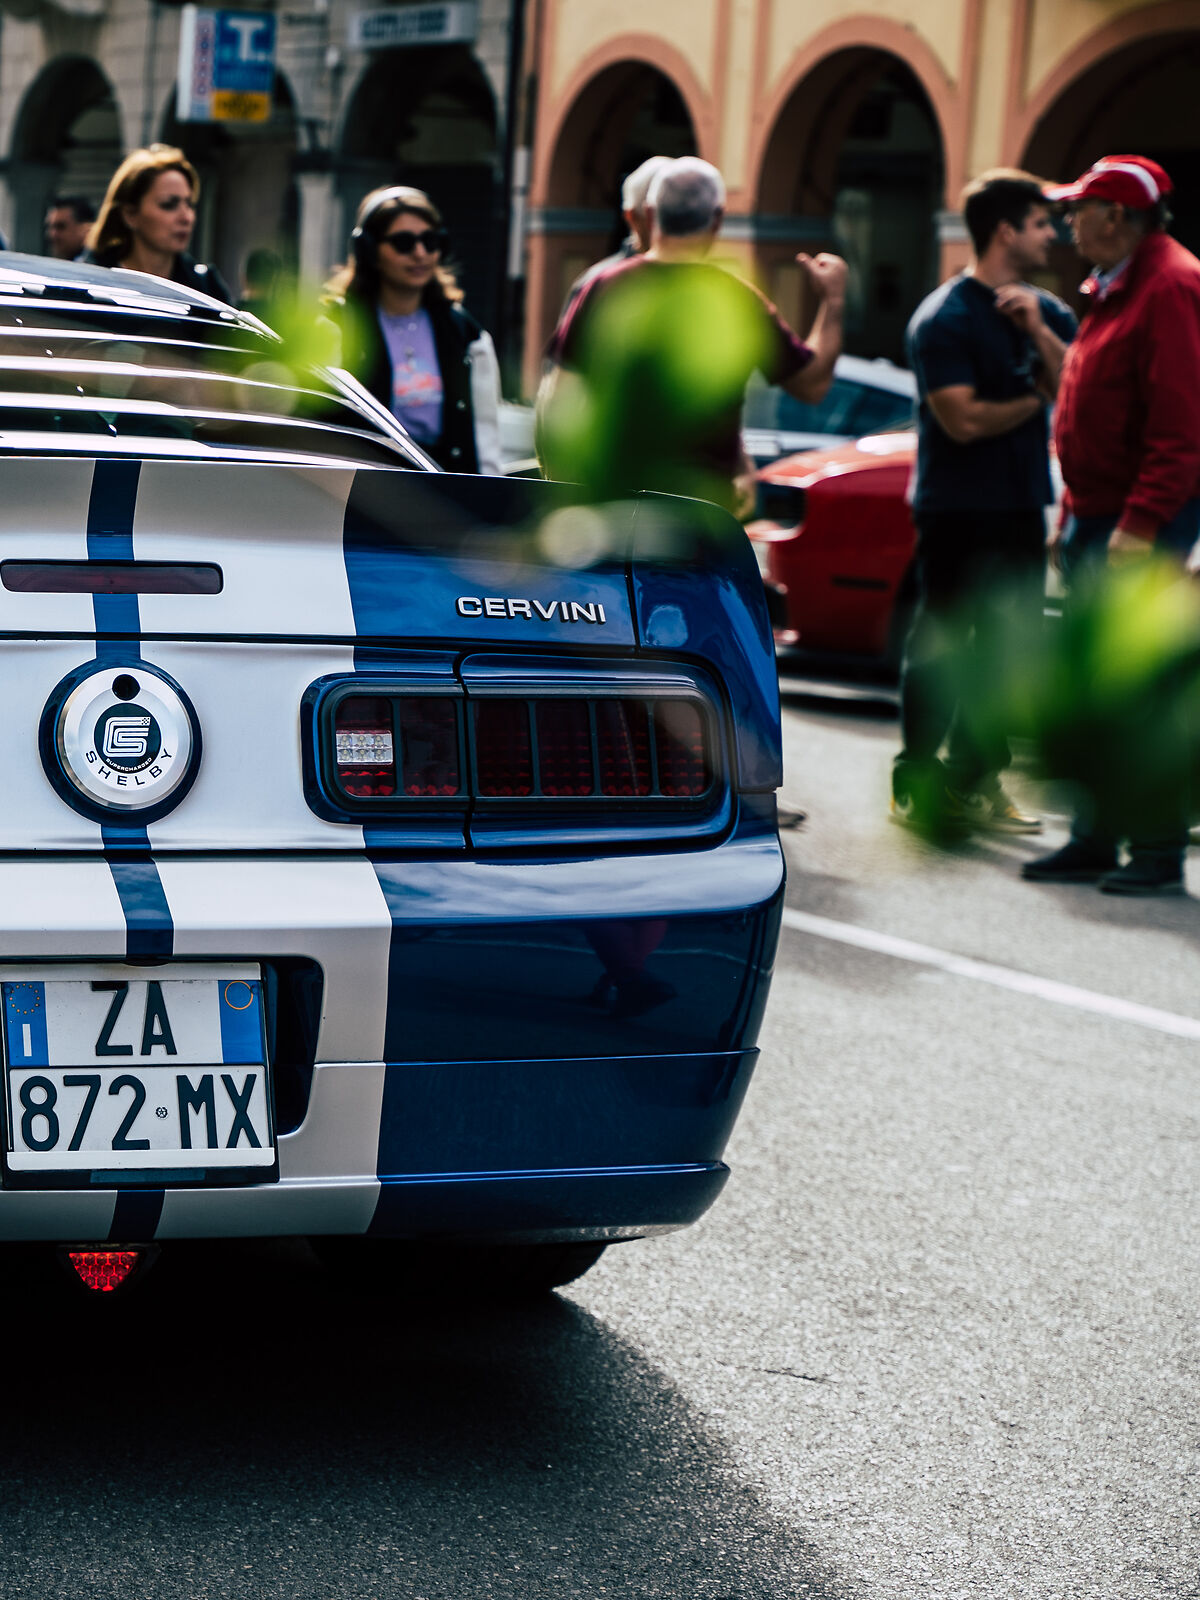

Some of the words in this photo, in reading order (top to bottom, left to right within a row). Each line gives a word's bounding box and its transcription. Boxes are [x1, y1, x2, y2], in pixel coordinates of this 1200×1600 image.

[456, 596, 607, 625] CERVINI
[85, 748, 173, 787] SHELBY
[105, 757, 153, 772] SUPERCHARGED
[90, 980, 178, 1057] ZA
[22, 1023, 33, 1057] I
[19, 1074, 151, 1151] 872
[176, 1073, 263, 1150] MX
